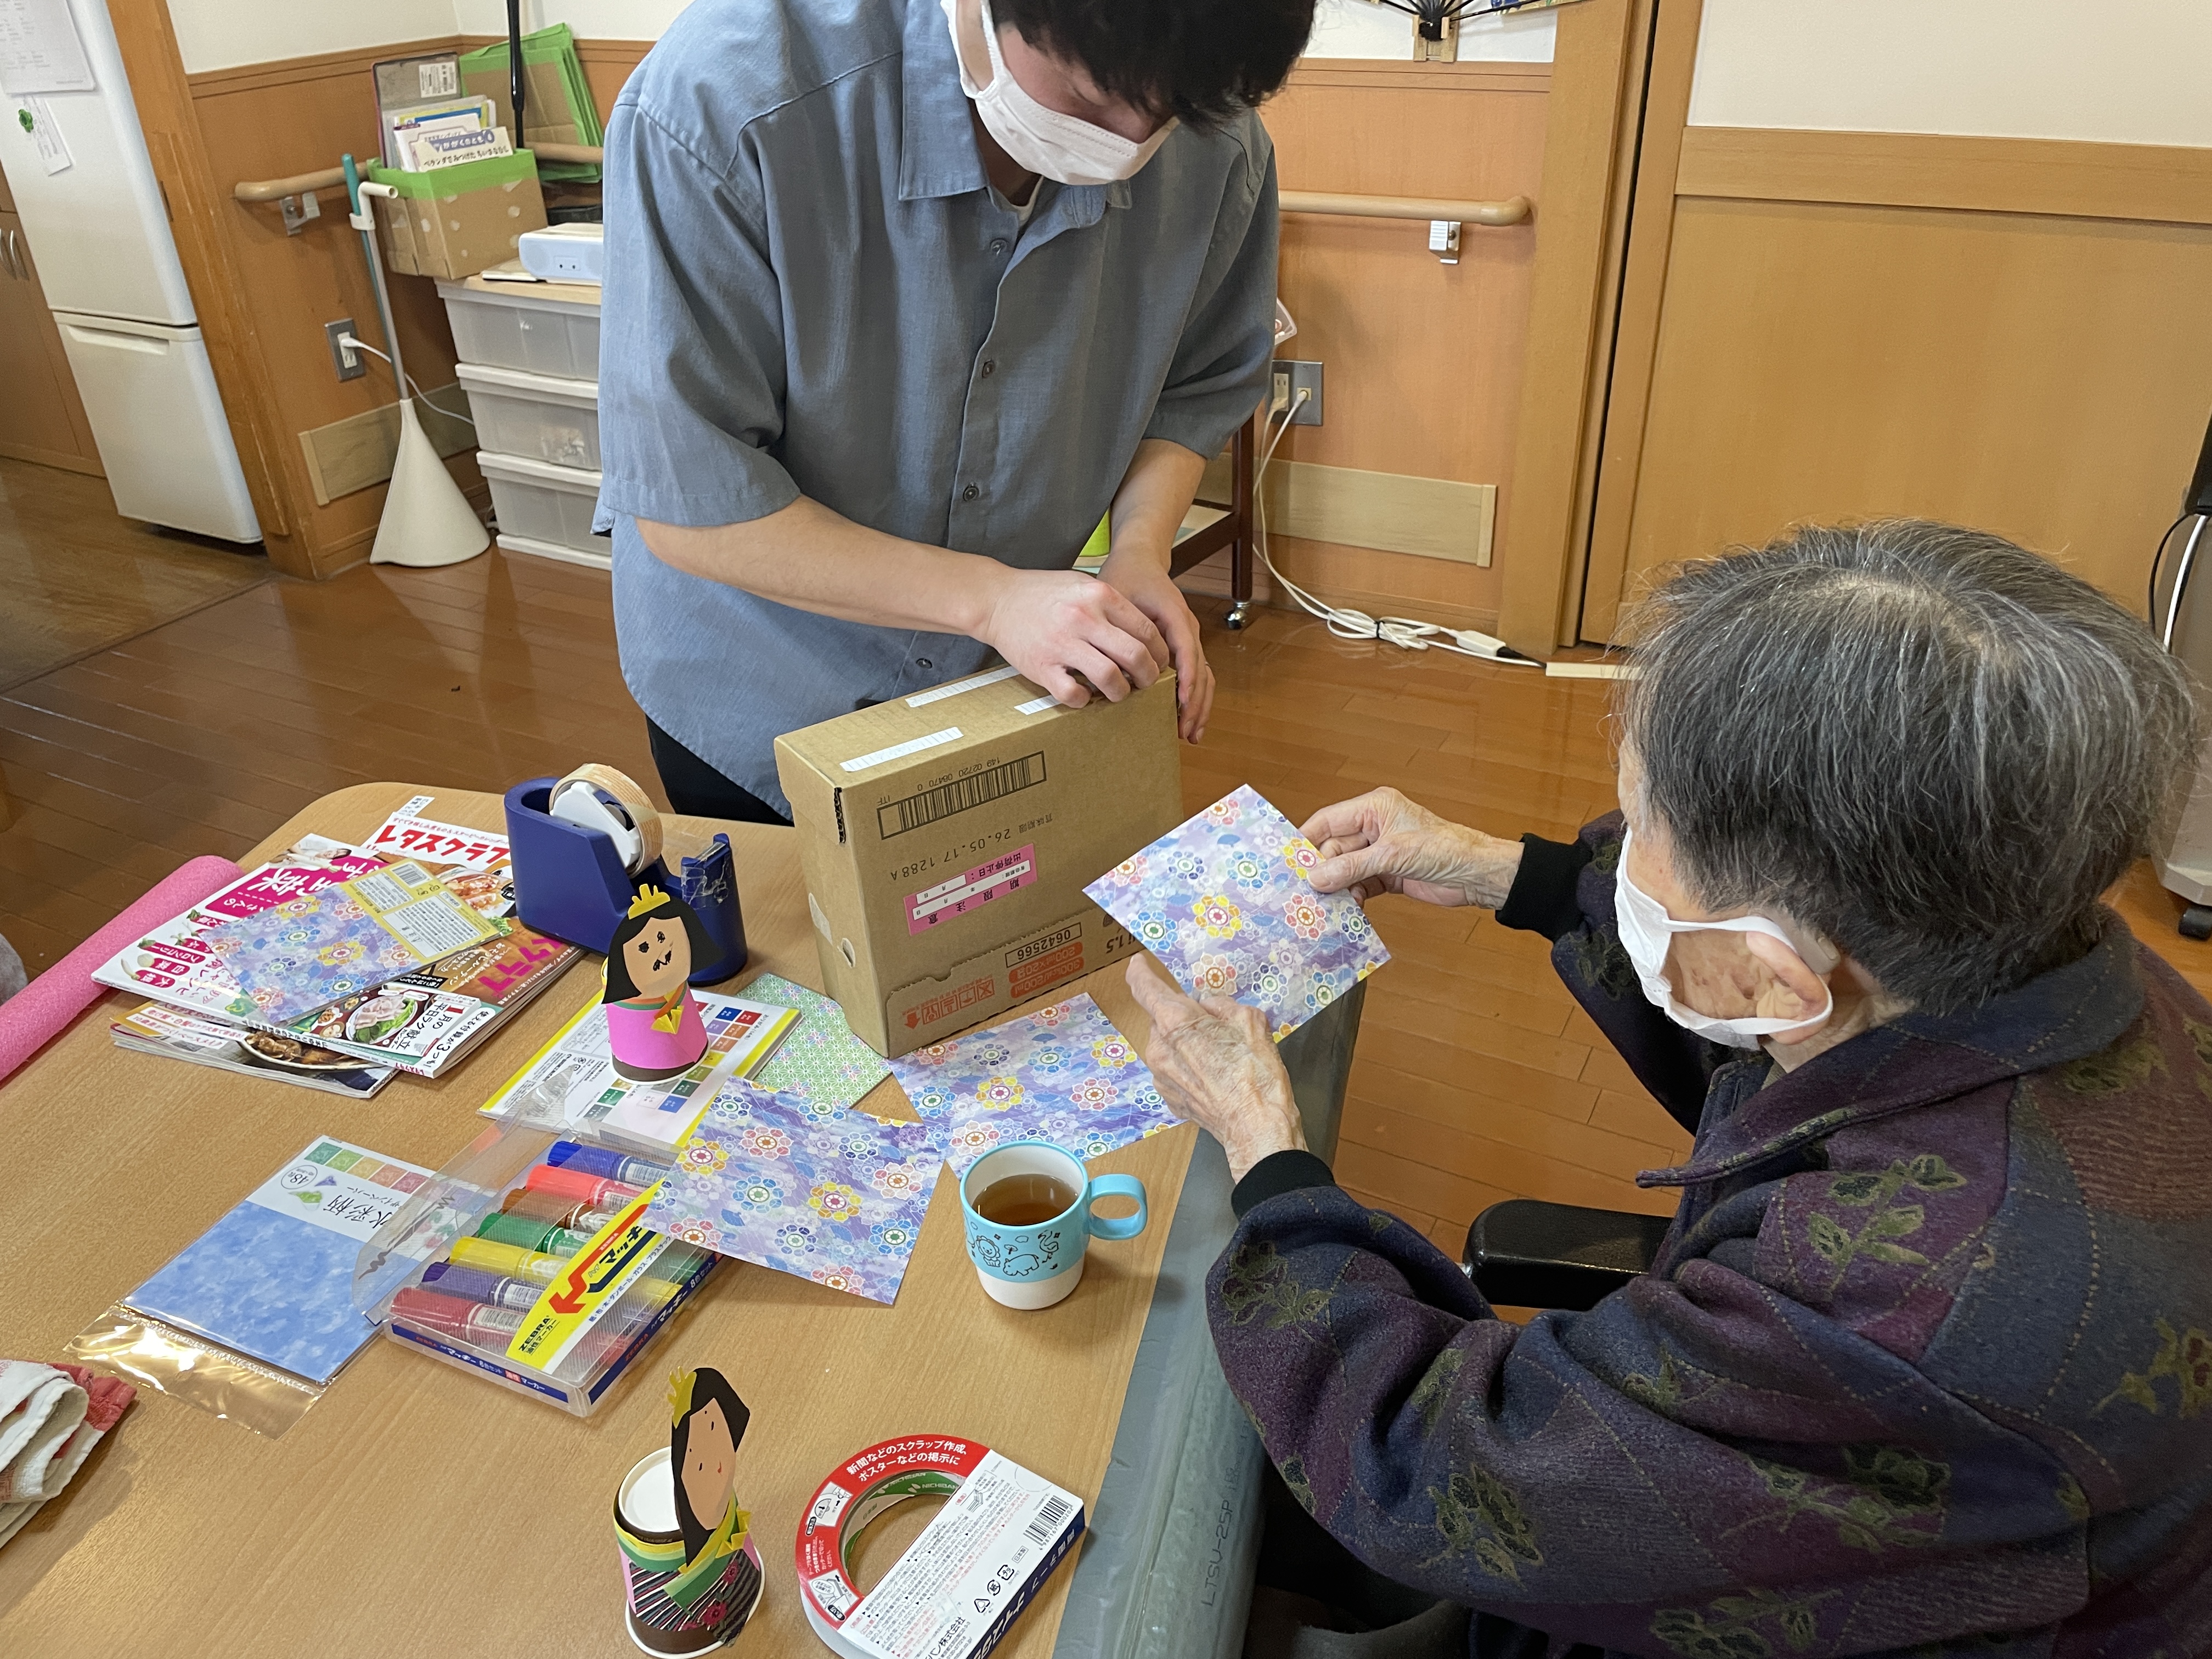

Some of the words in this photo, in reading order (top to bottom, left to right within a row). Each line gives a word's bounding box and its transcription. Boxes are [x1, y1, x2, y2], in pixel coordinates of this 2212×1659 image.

[877, 794, 891, 806] ITF
[1017, 813, 1054, 836] 賞味期限
[943, 828, 1012, 863] 26.05.17
[150, 944, 202, 964] ブロッコリー
[1015, 929, 1071, 960] 0642566
[140, 973, 172, 987] 大根
[156, 961, 186, 974] 白菜
[396, 1002, 449, 1051] 平日ラク献立
[322, 1194, 394, 1230] 水彩柄
[598, 1232, 620, 1251] ZEBRA
[518, 1314, 550, 1352] ZEBRA
[525, 1319, 557, 1356] 油性マーカー
[845, 1440, 968, 1476] 新聞などのスクラップ作成、
[857, 1453, 960, 1482] ポスターなどの掲示に
